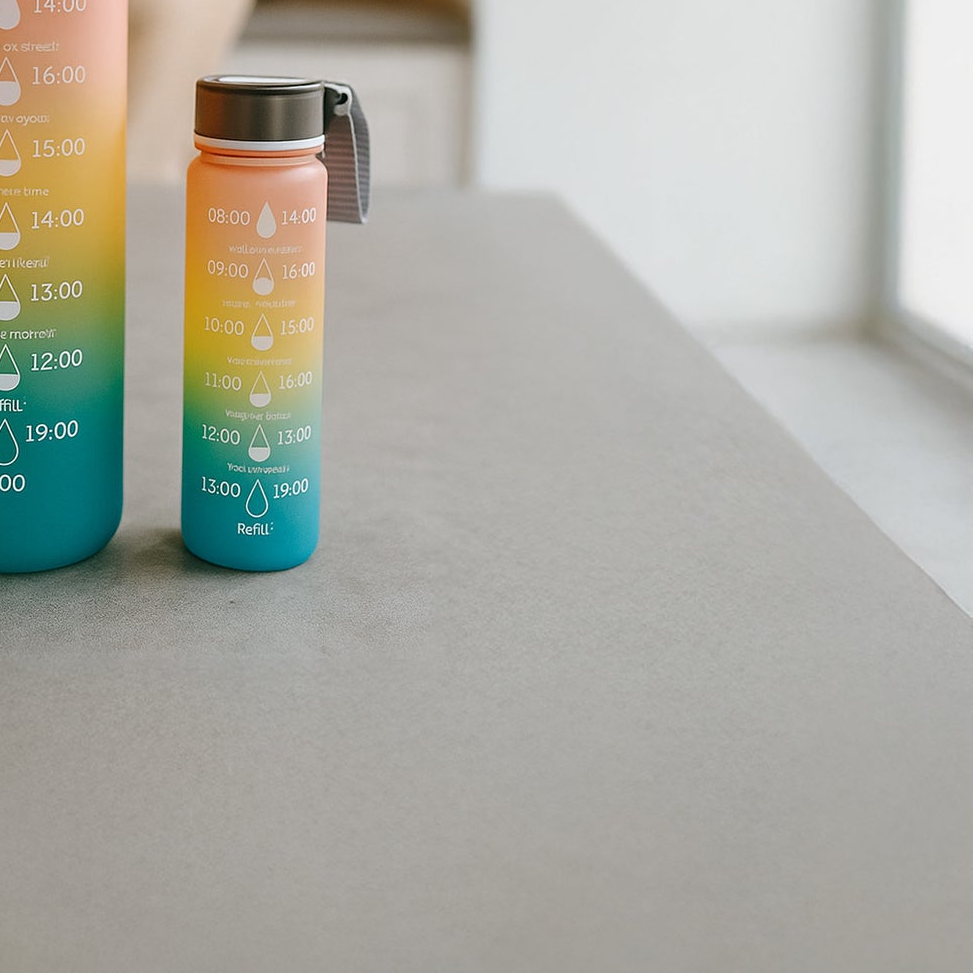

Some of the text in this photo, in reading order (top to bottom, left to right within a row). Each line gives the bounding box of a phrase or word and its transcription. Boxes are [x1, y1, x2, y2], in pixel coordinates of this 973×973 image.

[32, 65, 86, 86] 16:00
[32, 138, 86, 158] 15:00
[31, 208, 84, 230] 14:00
[208, 207, 317, 226] 08:00 14:00
[207, 259, 316, 280] 09:00 16:00
[31, 280, 83, 302] 13:00
[204, 316, 314, 336] 10:00 15:00
[31, 349, 83, 372] 12:00
[205, 371, 313, 391] 11:00 16:00
[26, 420, 78, 443] 19:00
[202, 424, 312, 446] 12:00 13:00
[201, 476, 309, 499] 13:00 19:00
